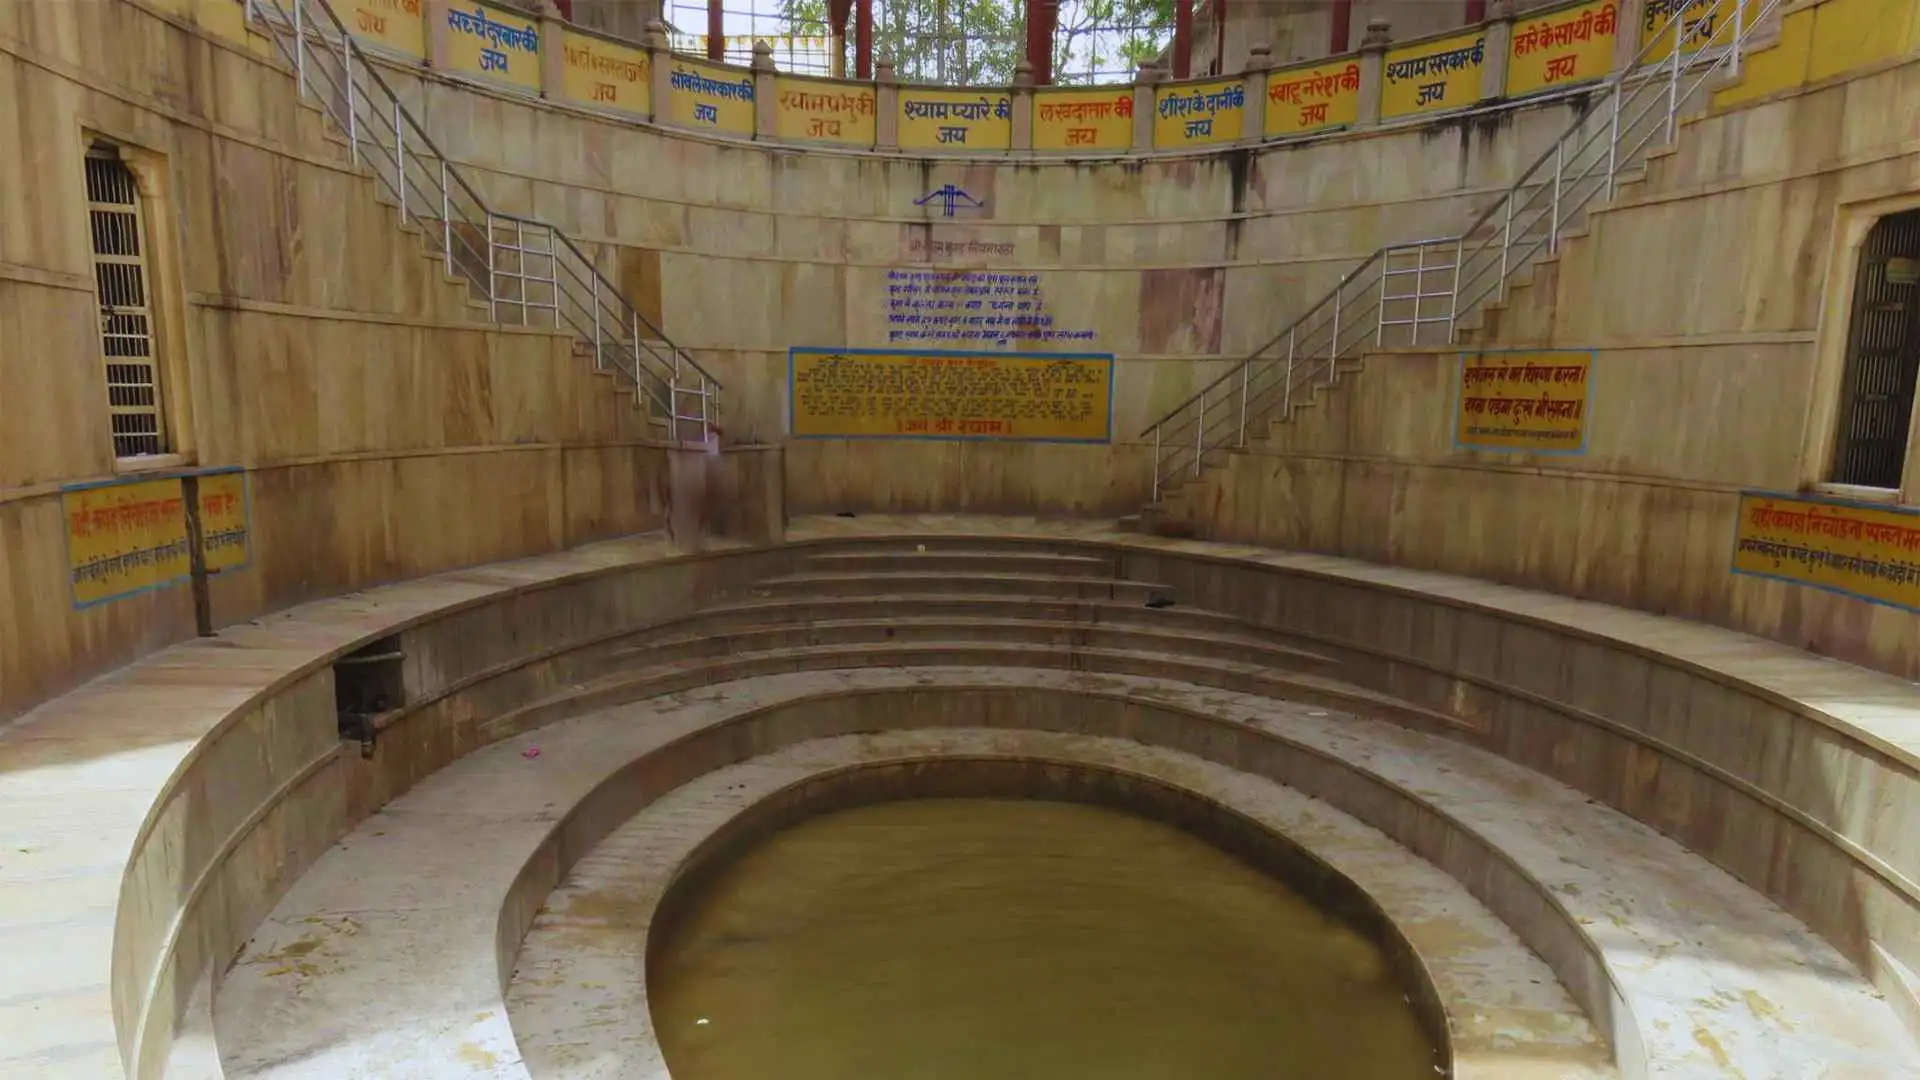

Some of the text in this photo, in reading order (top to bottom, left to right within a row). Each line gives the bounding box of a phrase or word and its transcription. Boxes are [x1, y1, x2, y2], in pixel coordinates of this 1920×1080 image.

[478, 47, 508, 73] जय
[1543, 53, 1577, 83] जय
[1416, 81, 1446, 105] जय
[694, 102, 718, 124] जय
[904, 99, 948, 121] श्याम
[1299, 102, 1328, 126] जय
[805, 119, 842, 137] जय
[935, 126, 968, 143] जय
[1064, 128, 1097, 146] जय
[1185, 118, 1212, 138] जय
